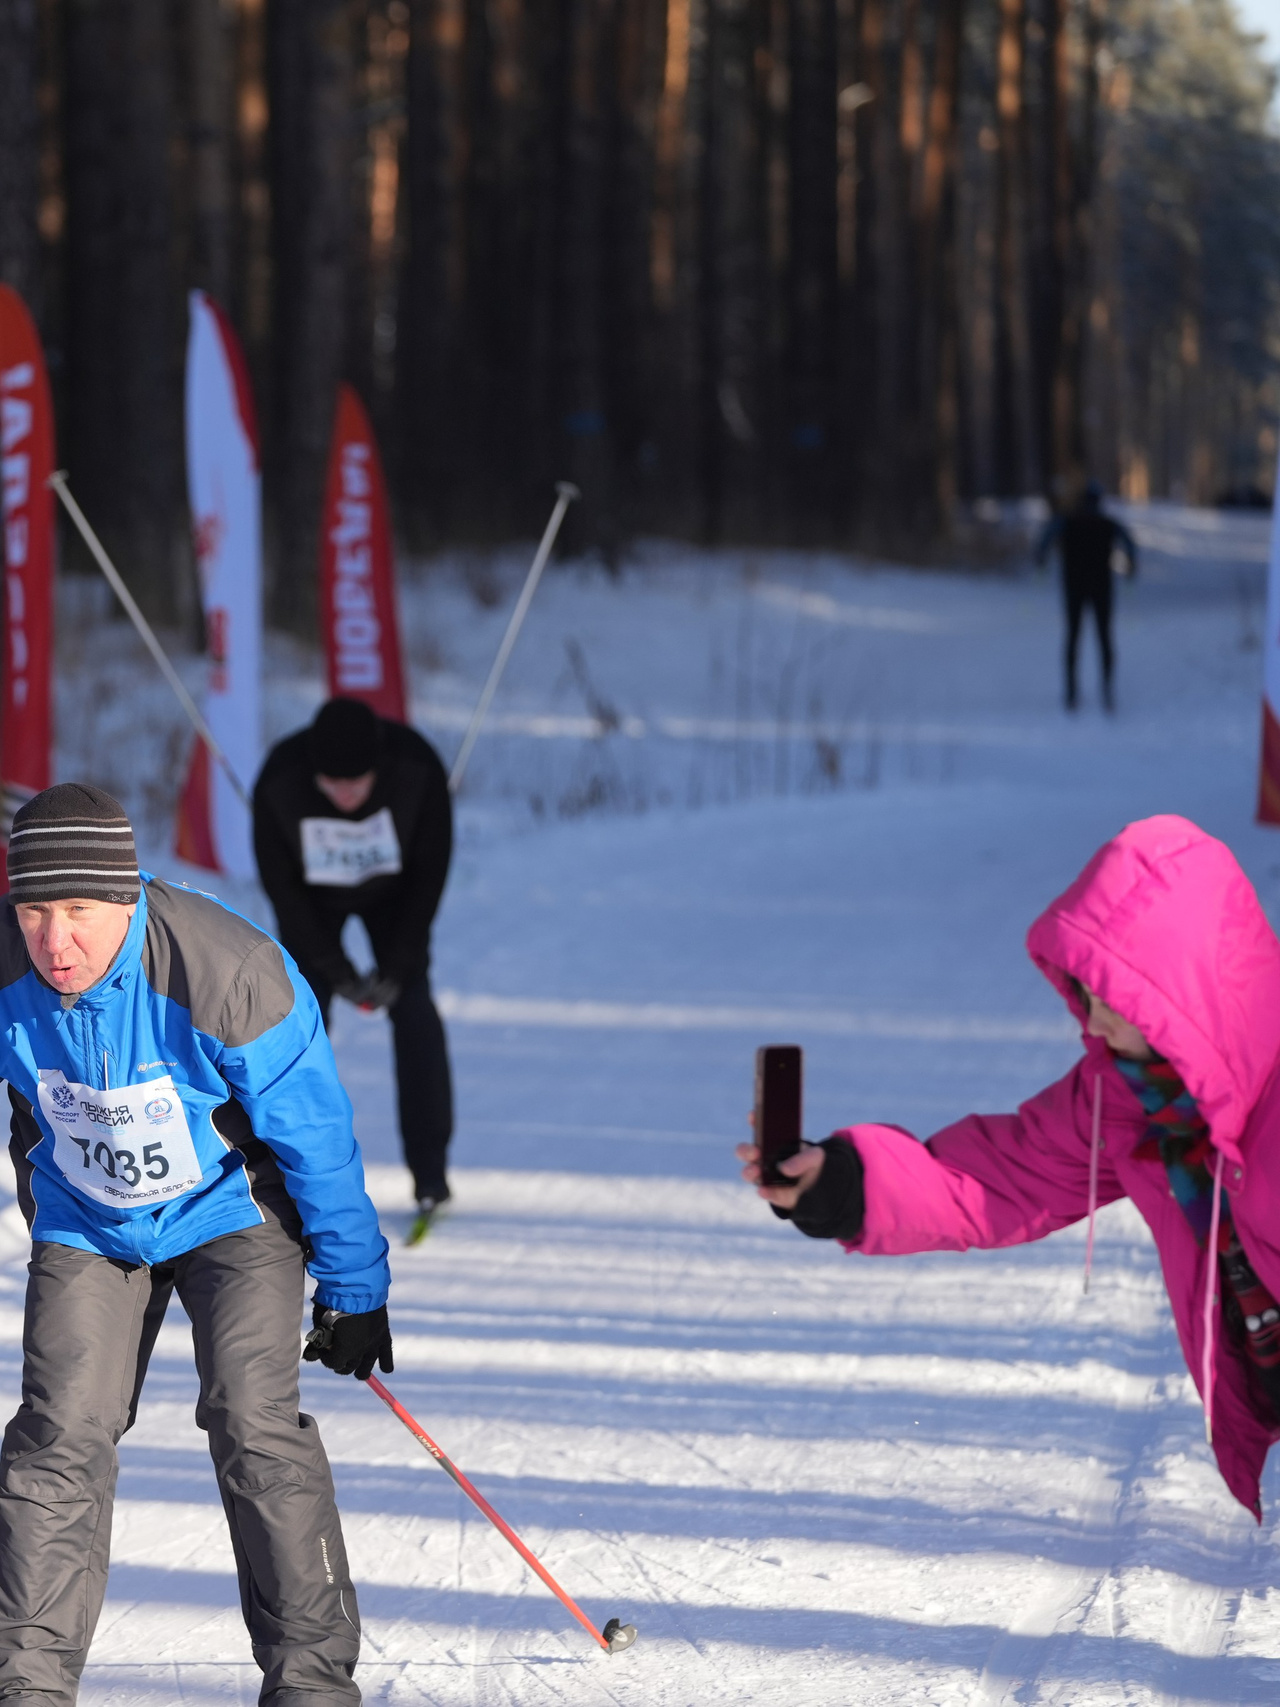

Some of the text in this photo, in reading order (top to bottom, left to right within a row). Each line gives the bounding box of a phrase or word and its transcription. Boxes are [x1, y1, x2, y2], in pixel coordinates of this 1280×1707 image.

[52, 1110, 80, 1118] МИНСПОРТ
[80, 1101, 130, 1117] ЛЫЖНЯ
[55, 1116, 77, 1124] РОССИИ
[68, 1135, 170, 1188] 7035
[104, 1185, 160, 1200] СВЕРДЛОВСКАЯ
[320, 1537, 332, 1573] NORDWAY
